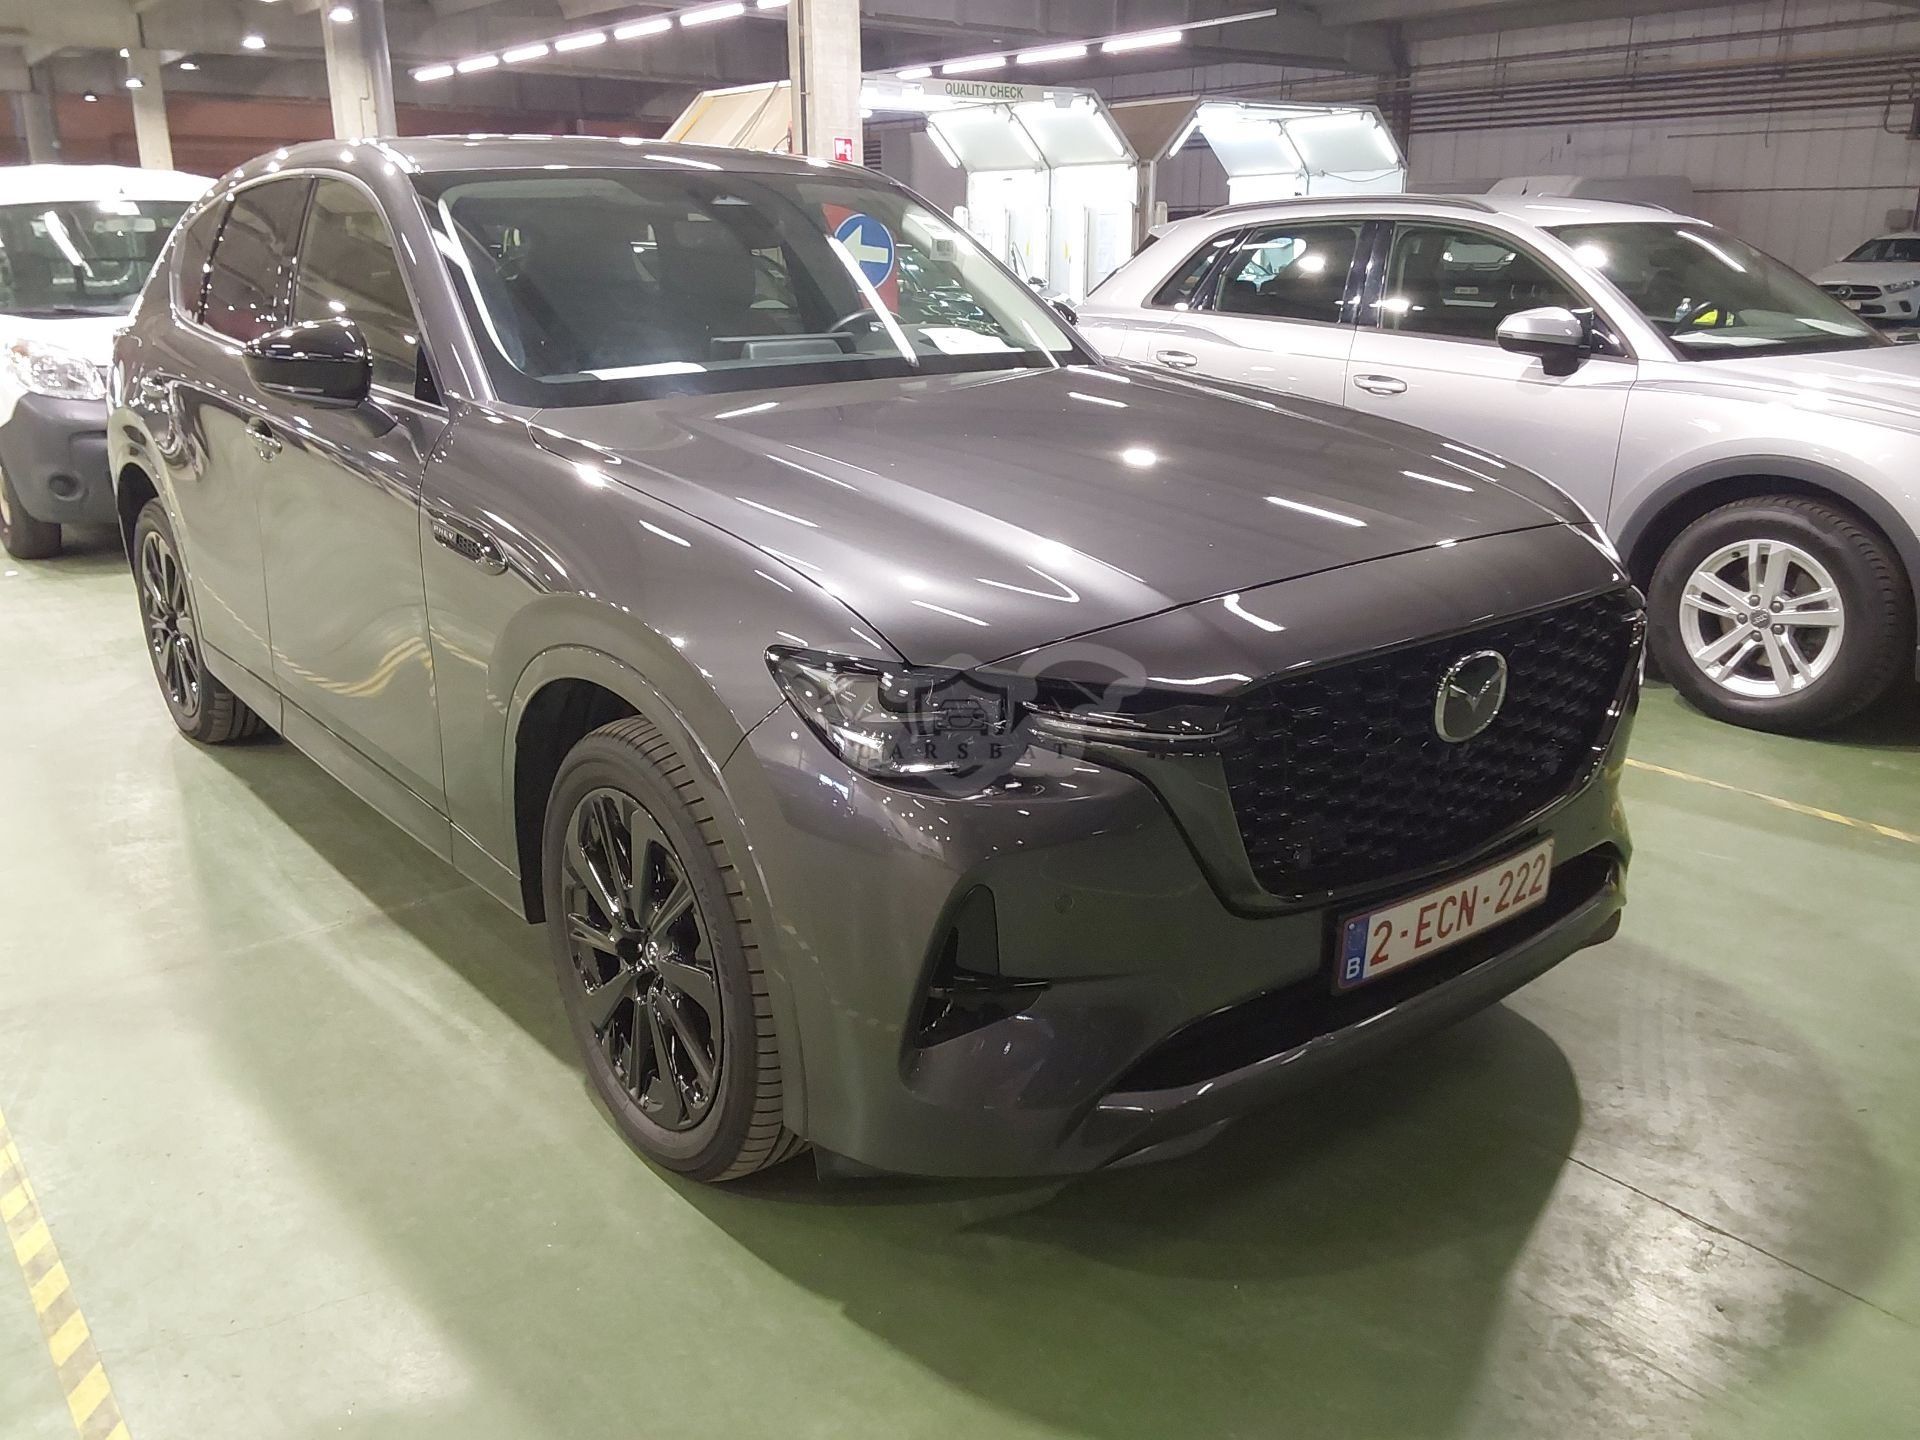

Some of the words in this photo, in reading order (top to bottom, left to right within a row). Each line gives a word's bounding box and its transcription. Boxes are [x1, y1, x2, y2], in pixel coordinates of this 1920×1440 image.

[945, 83, 987, 96] QUALITY
[990, 85, 1024, 99] CHECK
[1370, 853, 1546, 967] 2-ECN-222
[1346, 956, 1361, 980] B
